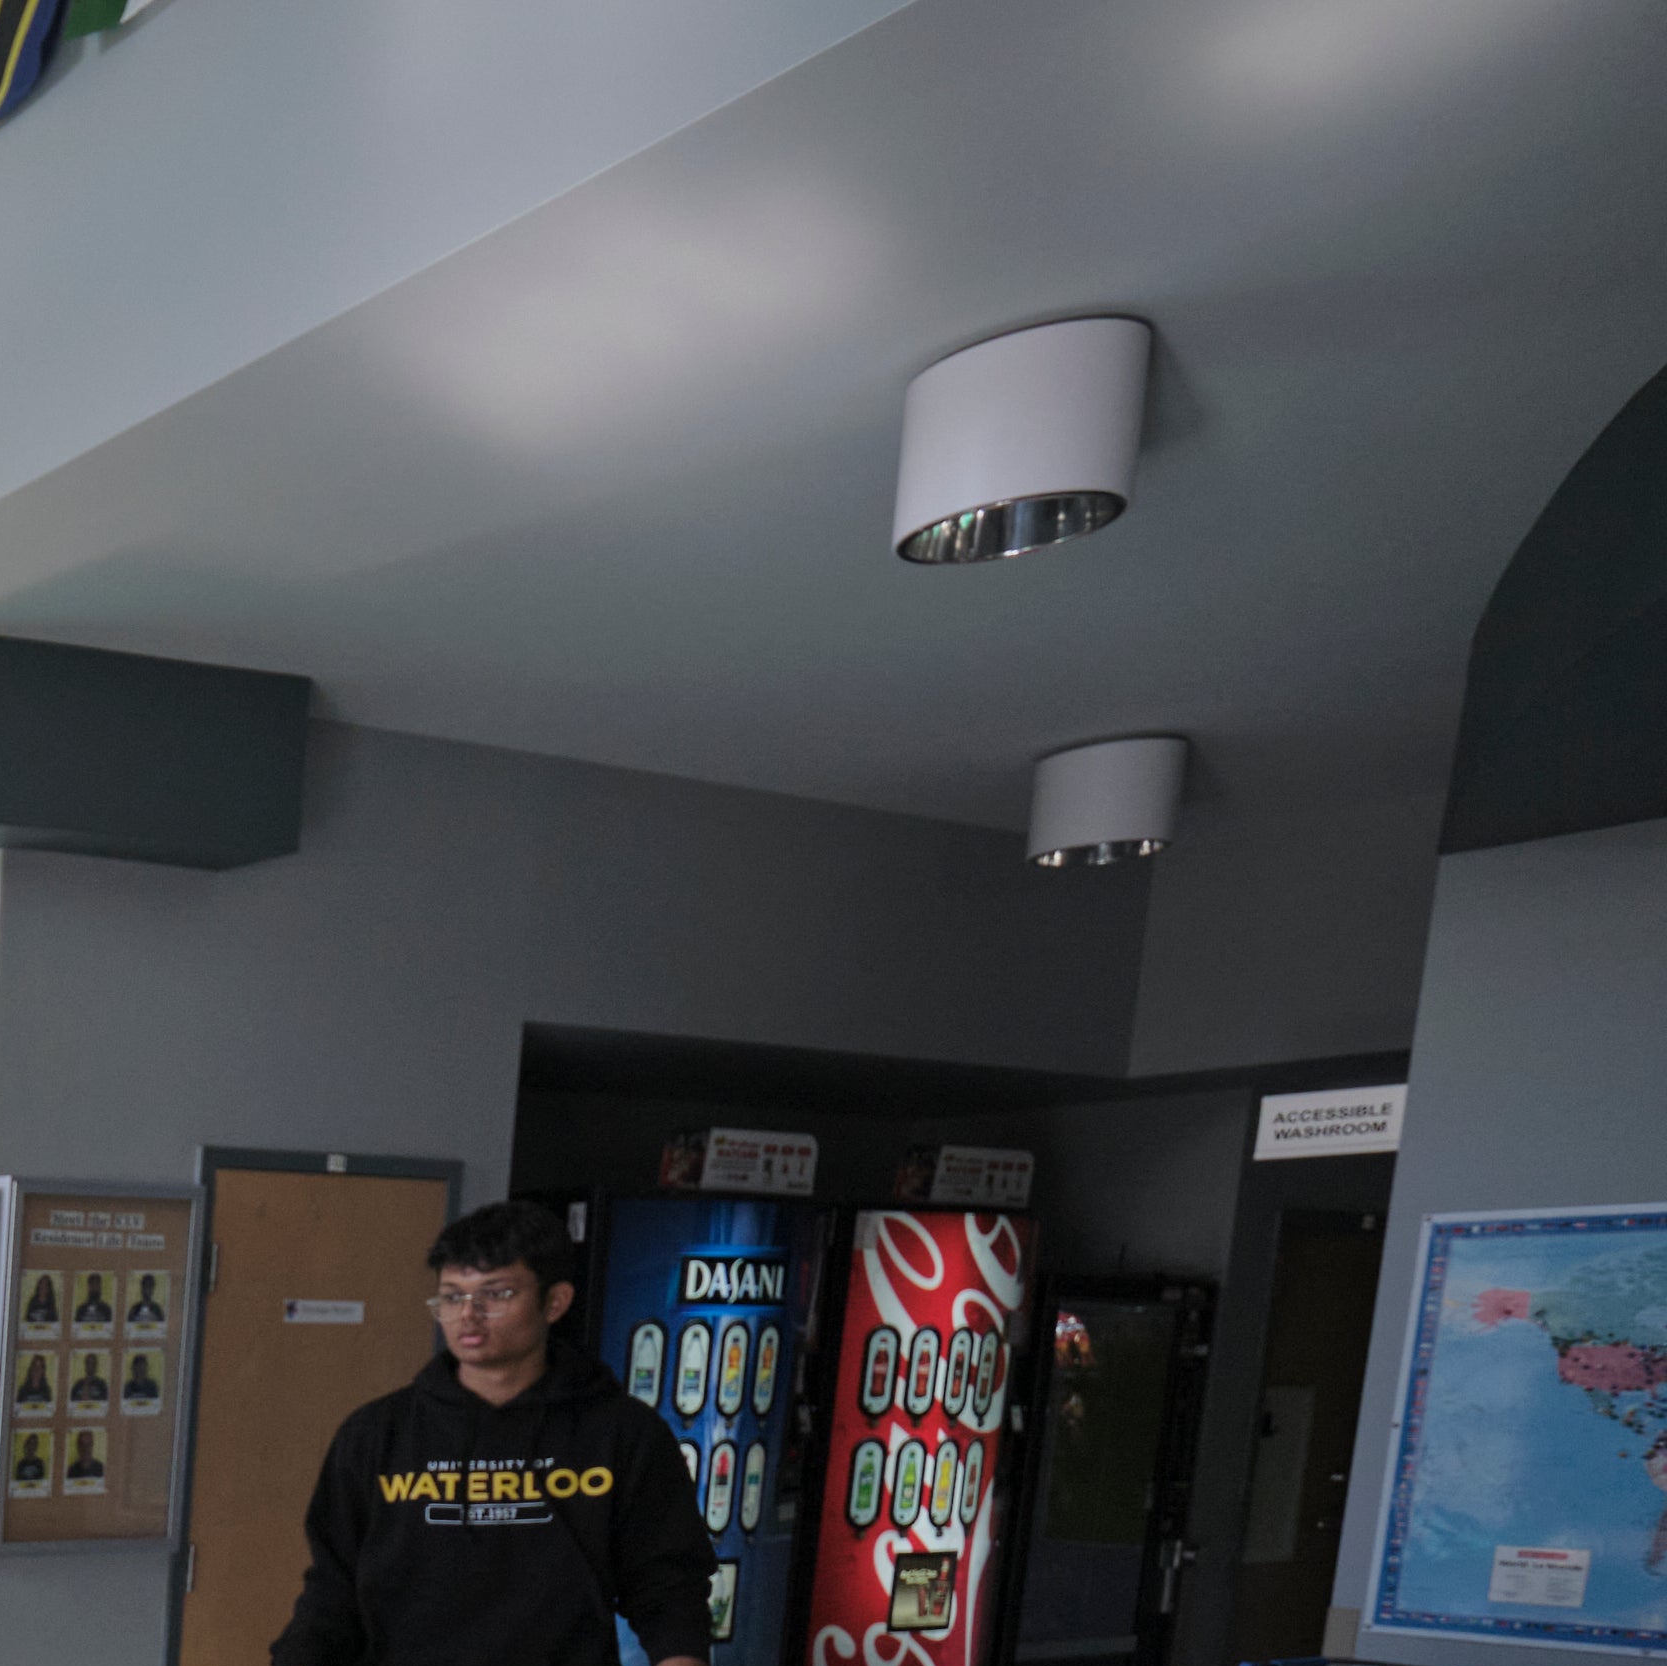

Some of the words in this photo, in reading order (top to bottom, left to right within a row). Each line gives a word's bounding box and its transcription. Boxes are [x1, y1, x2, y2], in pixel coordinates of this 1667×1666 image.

[1273, 1102, 1393, 1123] ACCESSIBLE
[1274, 1121, 1387, 1140] WASHROOM
[685, 1257, 785, 1304] DASANI
[427, 1458, 526, 1472] UNIERSITY
[379, 1466, 614, 1504] WATERLOO
